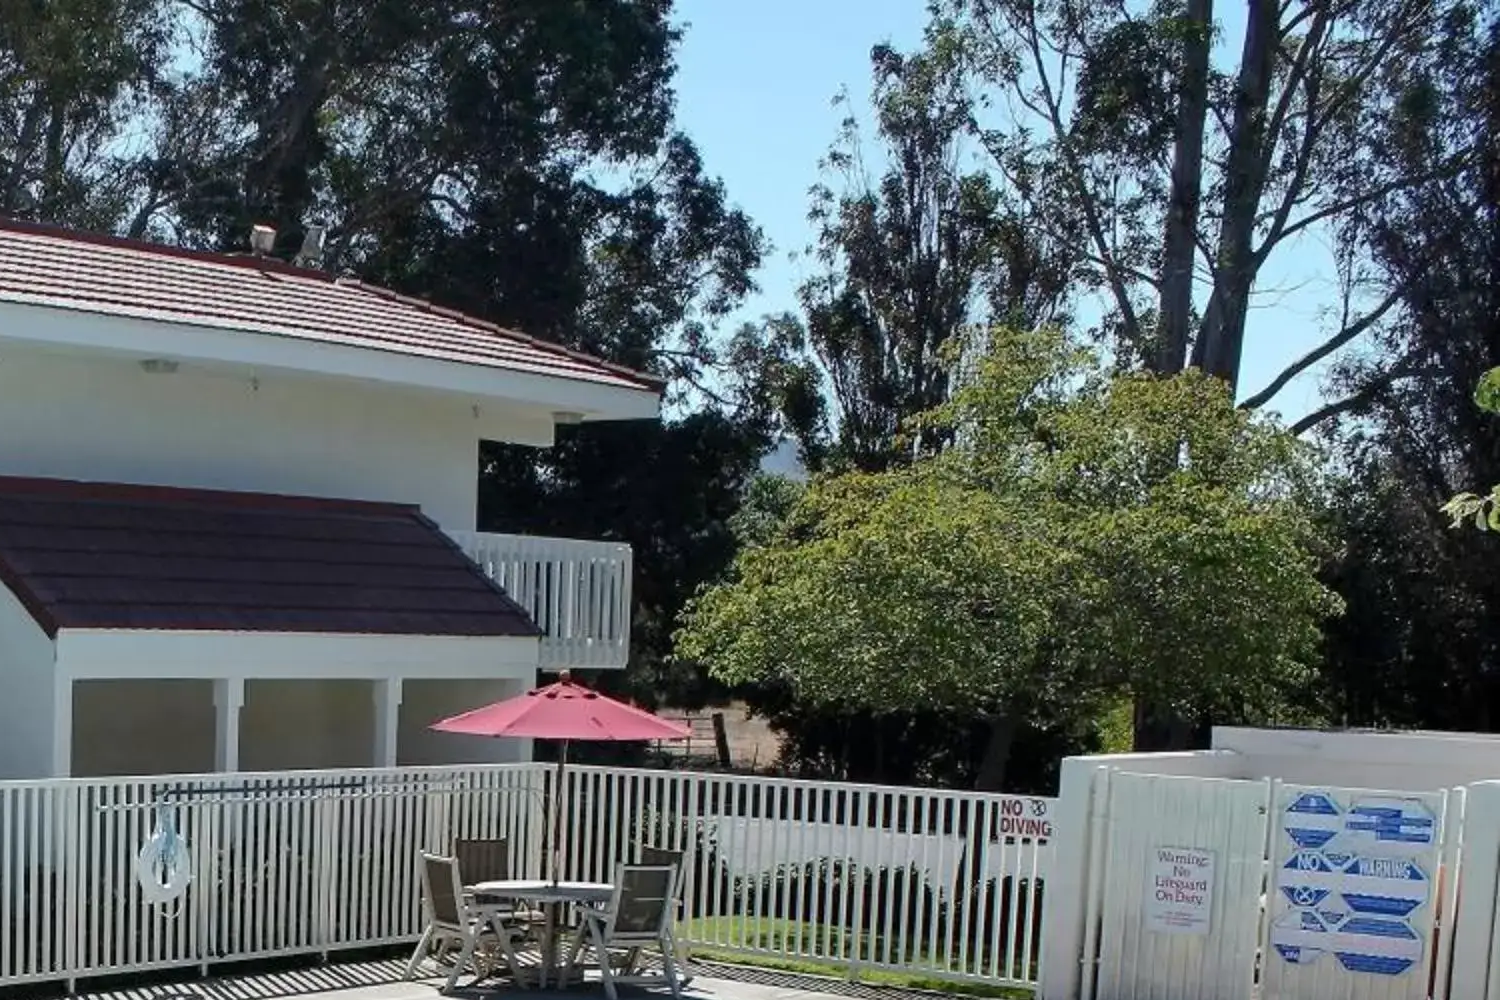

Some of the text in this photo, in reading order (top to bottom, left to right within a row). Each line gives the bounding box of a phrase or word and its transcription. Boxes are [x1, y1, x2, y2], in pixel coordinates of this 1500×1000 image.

[1001, 799, 1023, 817] NO
[1001, 818, 1053, 836] DIVING
[1298, 854, 1321, 871] NO
[1155, 890, 1173, 901] On
